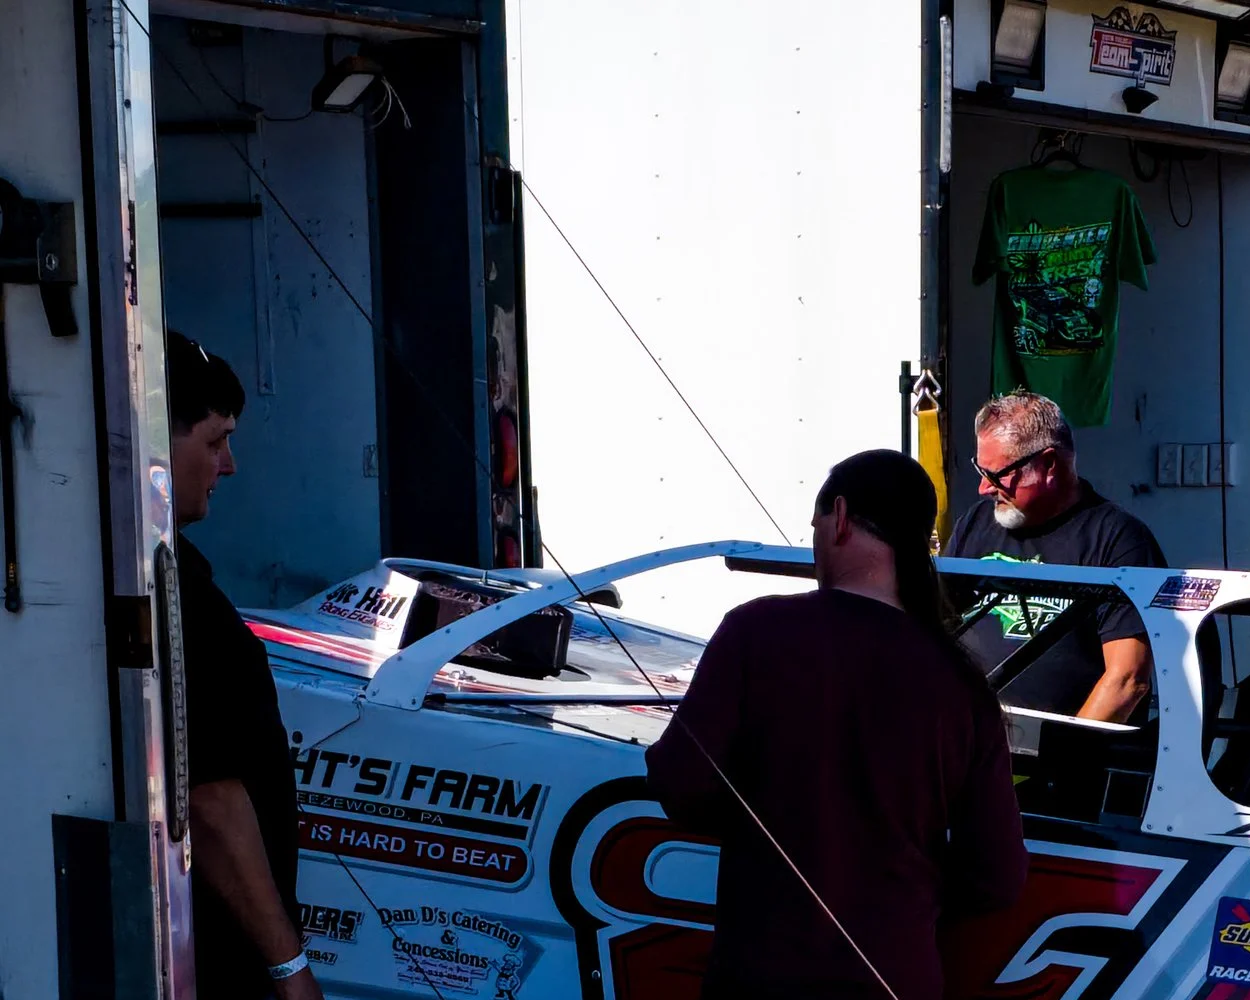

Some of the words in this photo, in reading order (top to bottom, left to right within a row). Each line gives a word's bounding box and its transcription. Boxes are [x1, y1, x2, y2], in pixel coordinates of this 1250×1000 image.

[355, 586, 408, 620] Hill
[291, 747, 392, 795] HT'S
[402, 764, 542, 820] FARM
[297, 791, 411, 821] EEZEWOOD,
[420, 812, 444, 825] PA
[310, 823, 332, 842] IS
[339, 827, 406, 854] HARD
[413, 839, 445, 860] TO
[452, 846, 517, 872] BEAT
[300, 905, 361, 933] DERS'
[377, 908, 416, 925] Dan
[420, 906, 447, 924] D's
[451, 911, 521, 949] Catering
[392, 937, 489, 969] Concessions
[441, 929, 456, 946] &
